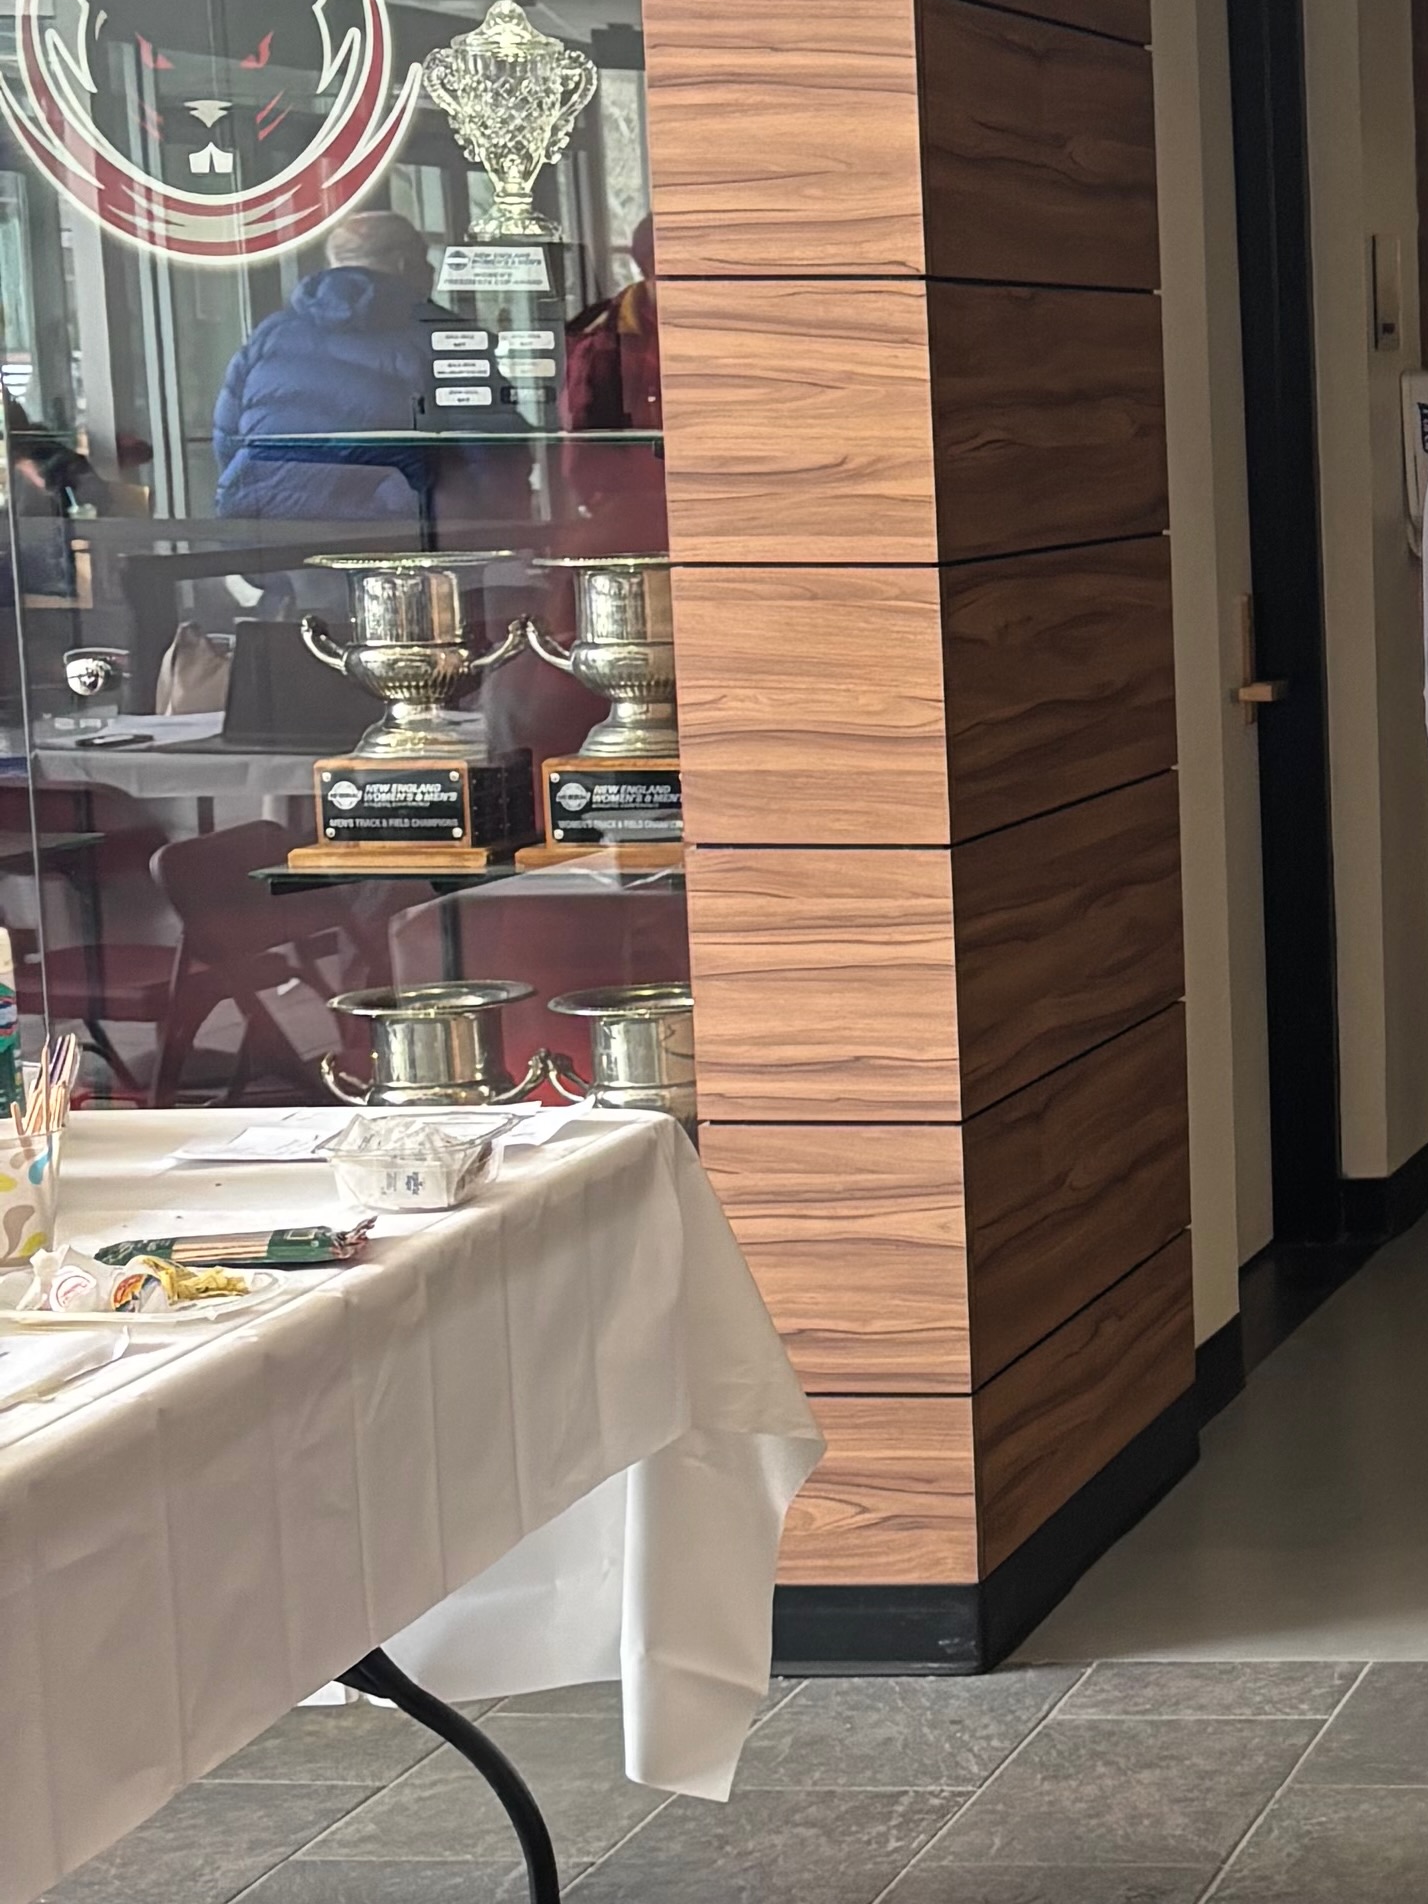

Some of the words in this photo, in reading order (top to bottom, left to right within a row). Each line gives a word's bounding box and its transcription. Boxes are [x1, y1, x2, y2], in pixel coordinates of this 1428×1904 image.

[365, 783, 391, 793] NEW
[391, 783, 442, 793] ENGLAND
[593, 784, 620, 794] NEW
[620, 784, 672, 794] ENGLAND
[388, 818, 410, 828] FIELD
